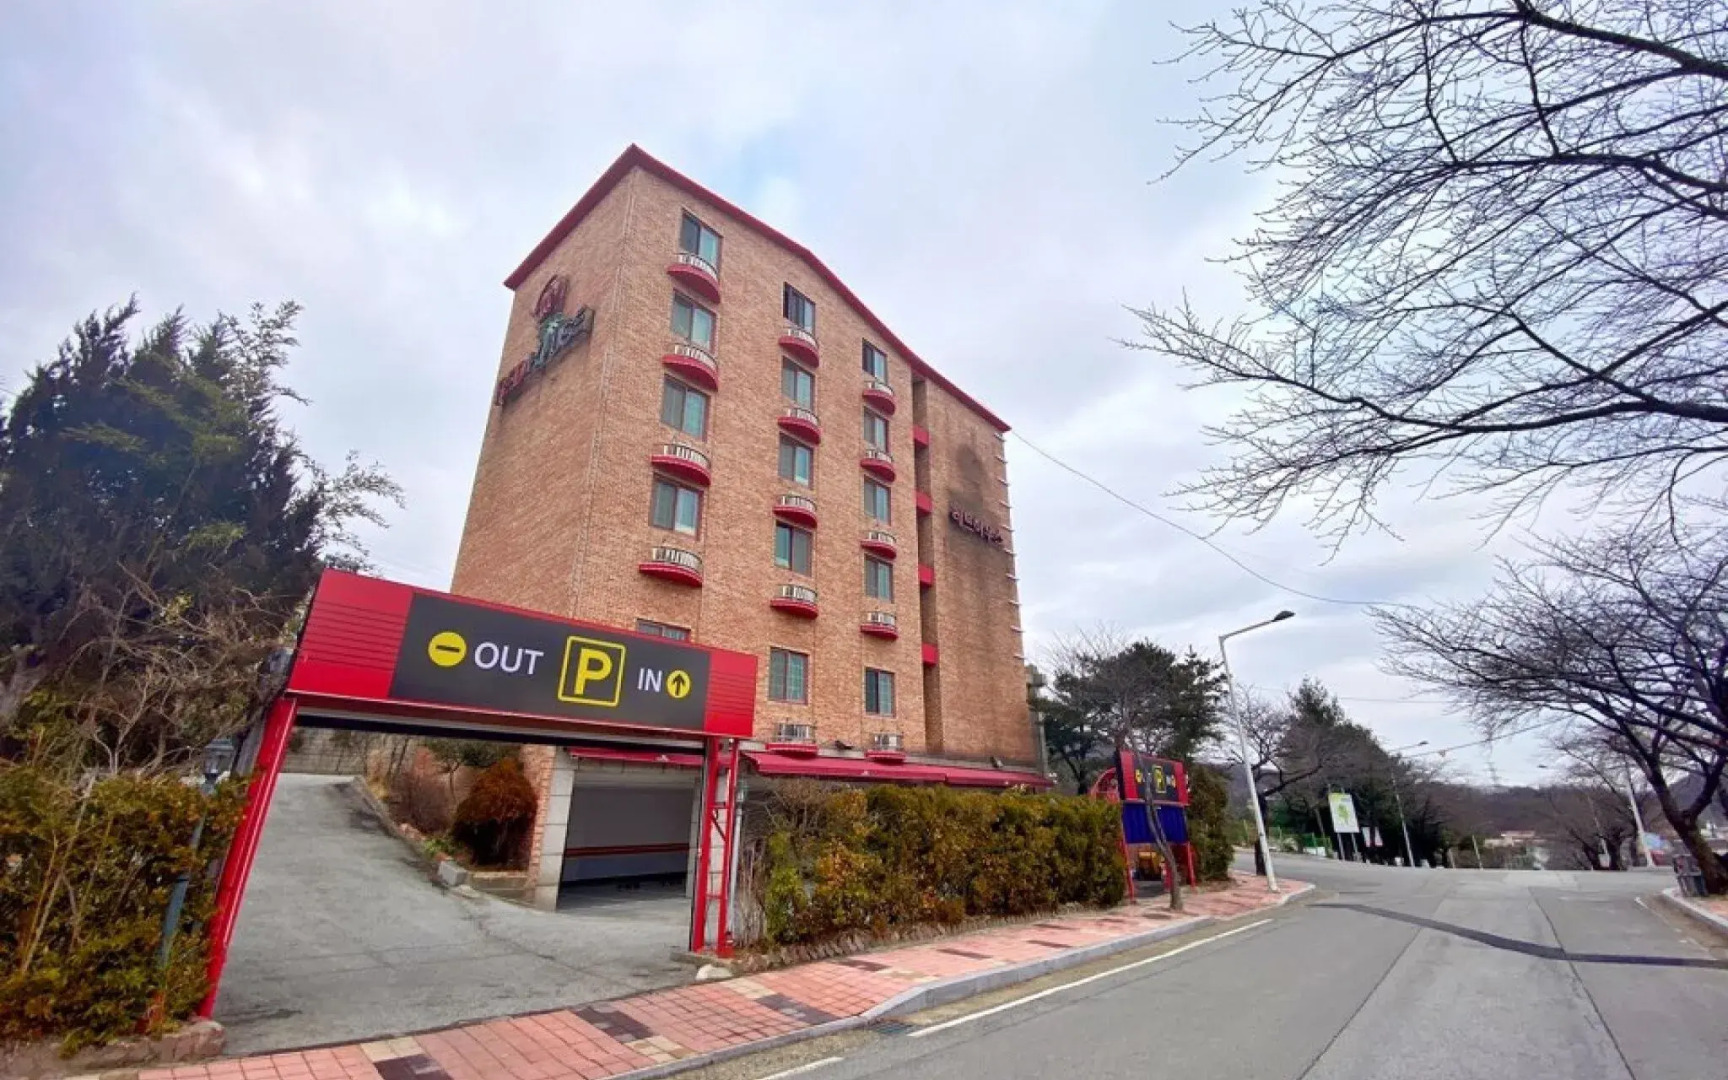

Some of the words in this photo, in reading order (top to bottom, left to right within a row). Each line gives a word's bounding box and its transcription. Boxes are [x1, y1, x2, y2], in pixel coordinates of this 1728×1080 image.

[474, 642, 544, 675] OUT
[574, 648, 613, 695] P
[638, 668, 662, 692] IN
